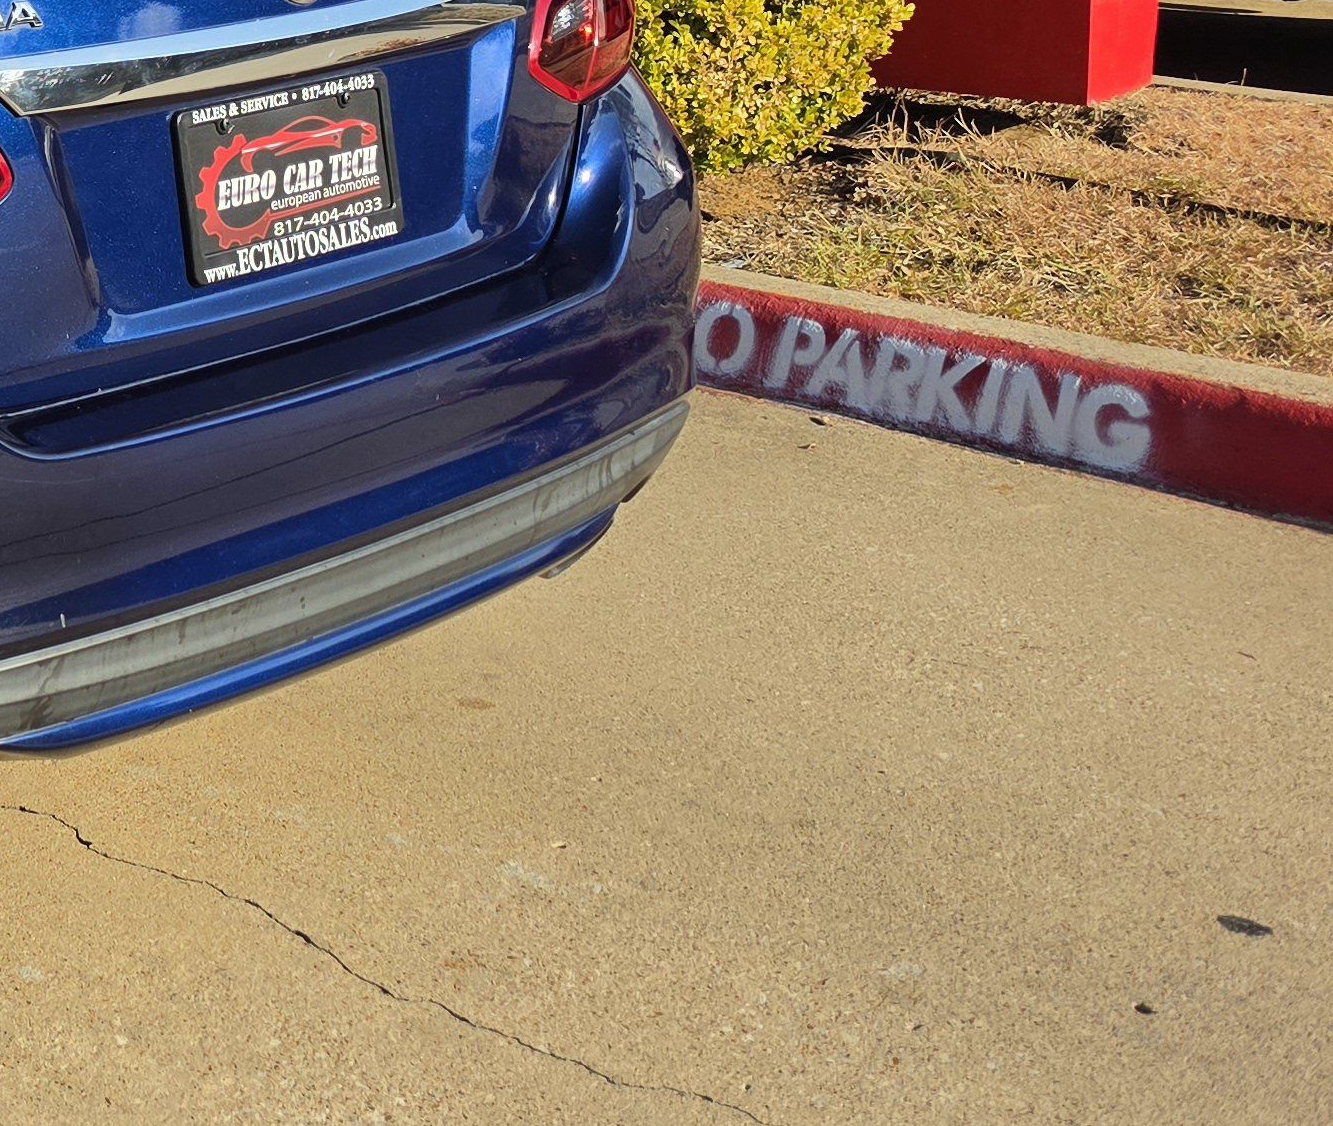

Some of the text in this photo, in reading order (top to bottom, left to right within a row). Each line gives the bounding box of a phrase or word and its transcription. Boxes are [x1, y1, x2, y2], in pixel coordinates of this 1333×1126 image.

[192, 74, 374, 124] SALES & SERVICE 817-404-4033
[217, 145, 378, 211] EURO CAR TECH
[270, 174, 381, 211] european automotive
[273, 196, 383, 237] 817-404-4033
[204, 217, 398, 283] www.ECTAUTOSALES.com
[693, 300, 1152, 474] O PARKING
